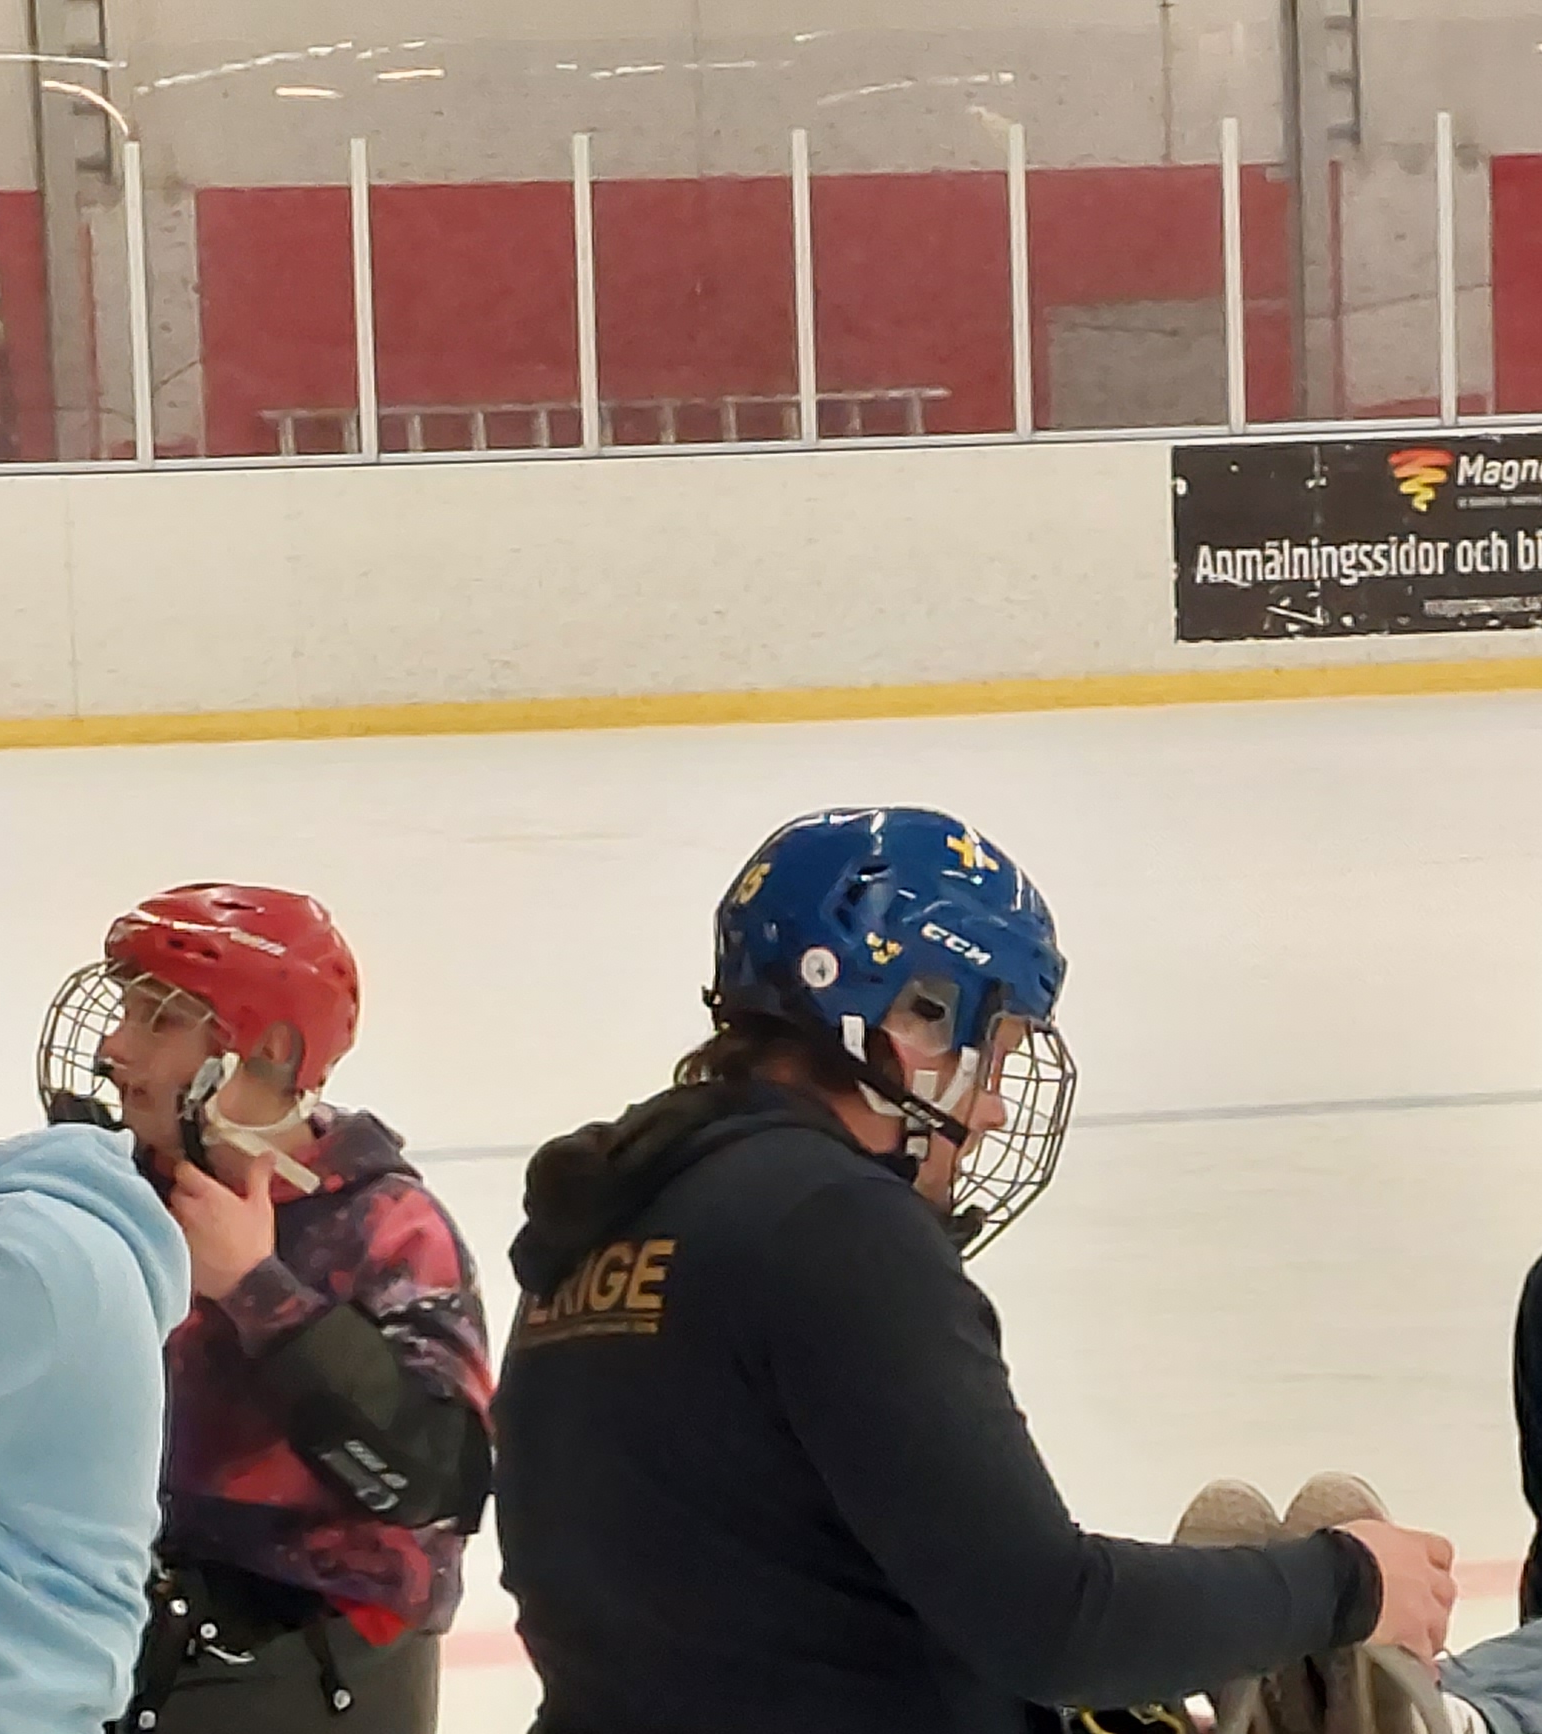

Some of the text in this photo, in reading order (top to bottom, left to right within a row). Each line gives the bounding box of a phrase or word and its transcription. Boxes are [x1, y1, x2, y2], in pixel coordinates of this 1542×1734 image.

[1195, 534, 1449, 586] Anmälningssidor
[1456, 530, 1509, 574] och
[921, 921, 992, 966] CCM
